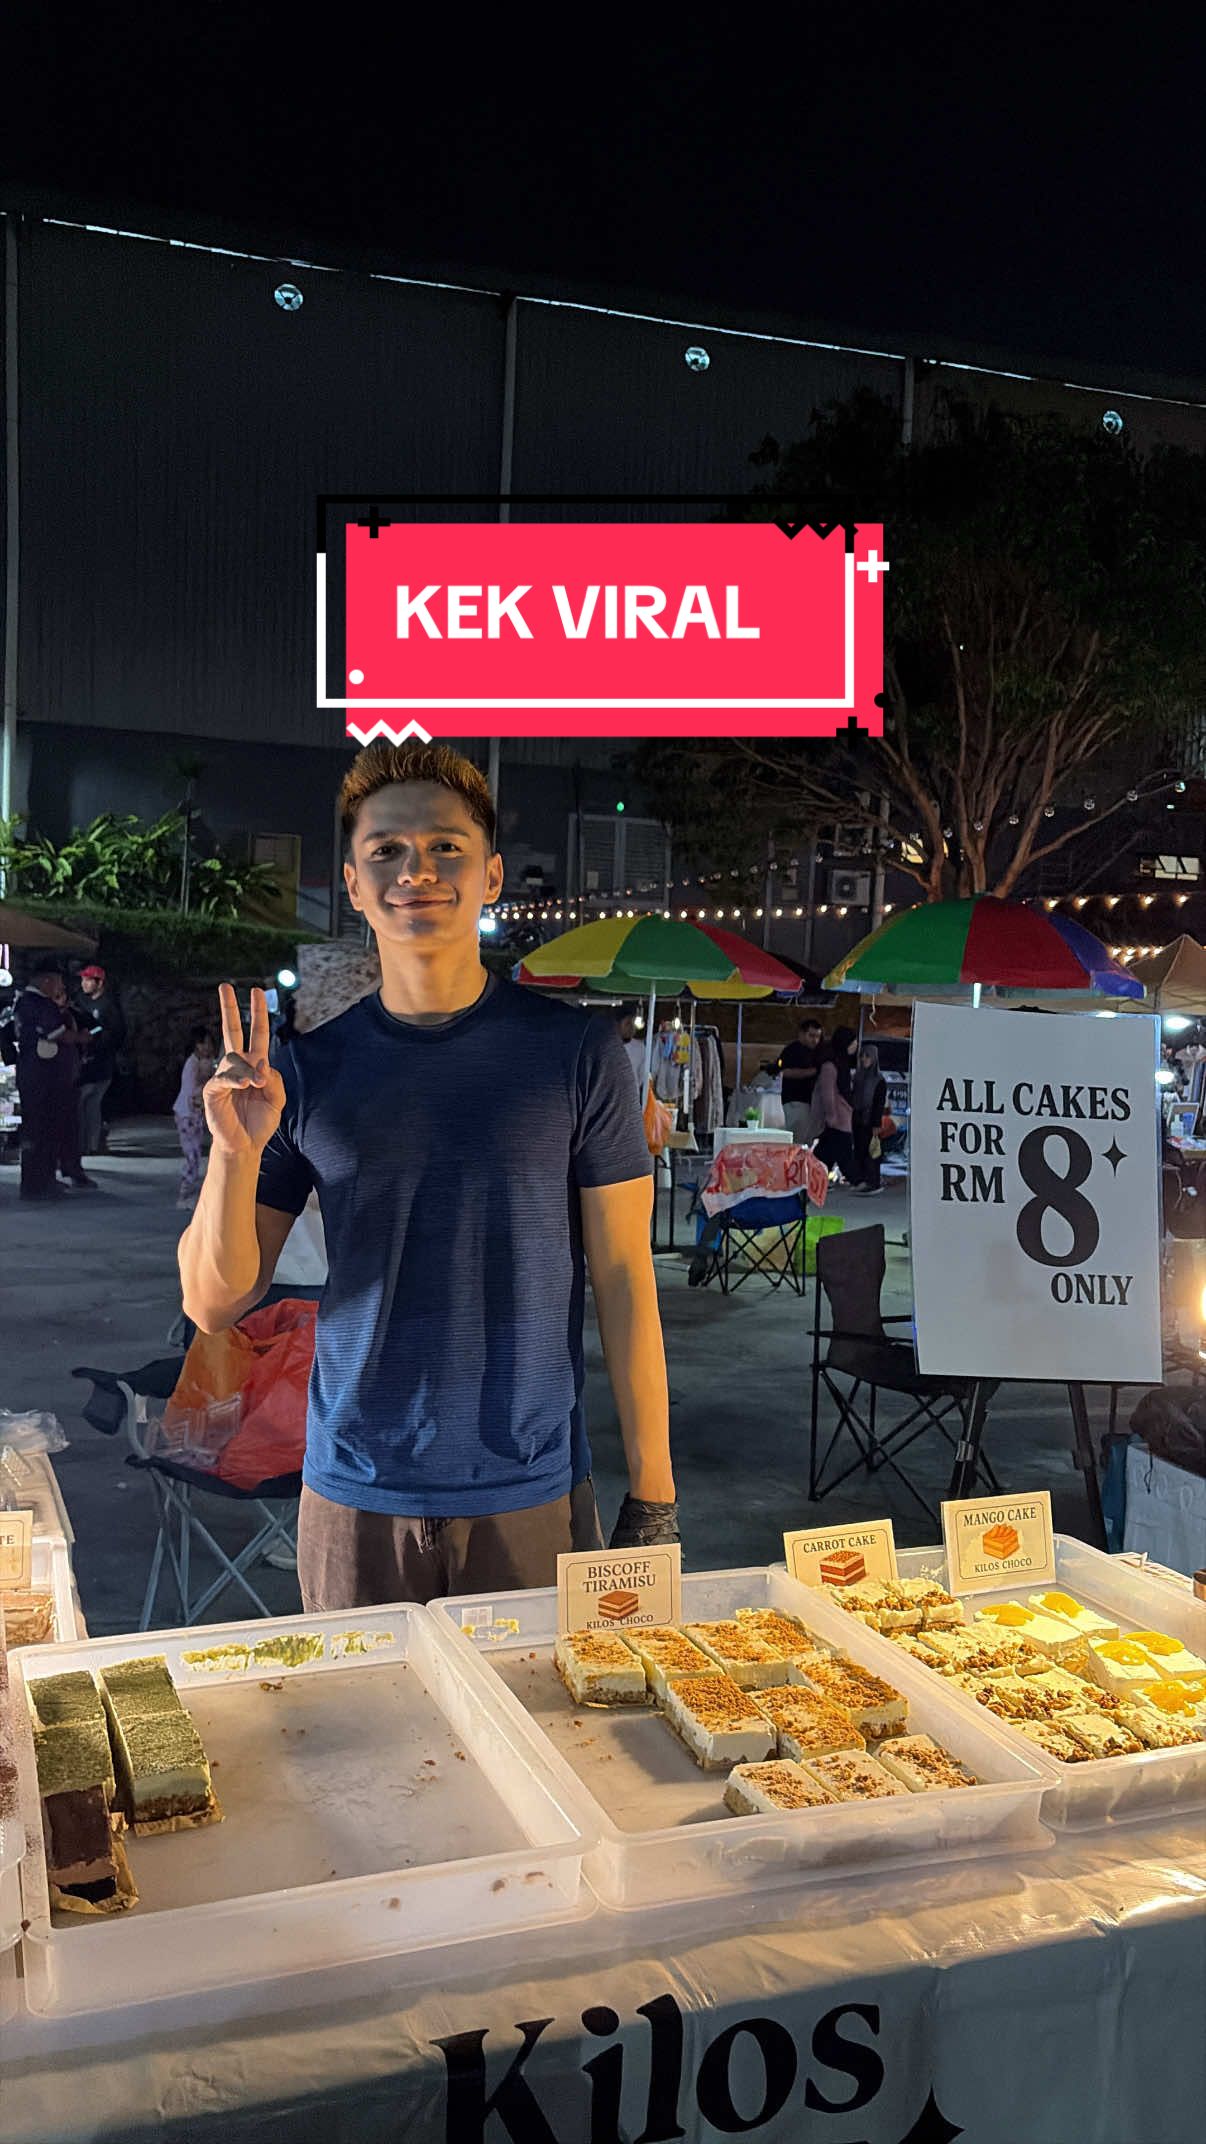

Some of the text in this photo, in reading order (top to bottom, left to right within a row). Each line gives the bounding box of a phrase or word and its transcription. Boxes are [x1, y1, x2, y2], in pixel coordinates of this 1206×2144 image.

[936, 1077, 1132, 1122] ALL CAKES
[939, 1121, 1006, 1156] FOR
[940, 1163, 1006, 1204] RM
[1016, 1125, 1100, 1268] 8
[1050, 1272, 1134, 1306] ONLY
[963, 1507, 1037, 1527] MANGO CAKE
[803, 1534, 877, 1553] CARROT CAKE
[588, 1560, 651, 1579] BISCOFF
[975, 1557, 1033, 1573] KILOS CHOCO
[583, 1573, 656, 1593] TIRAMISU
[586, 1614, 654, 1630] KILOS CHOCO
[428, 1993, 885, 2144] Kilos
